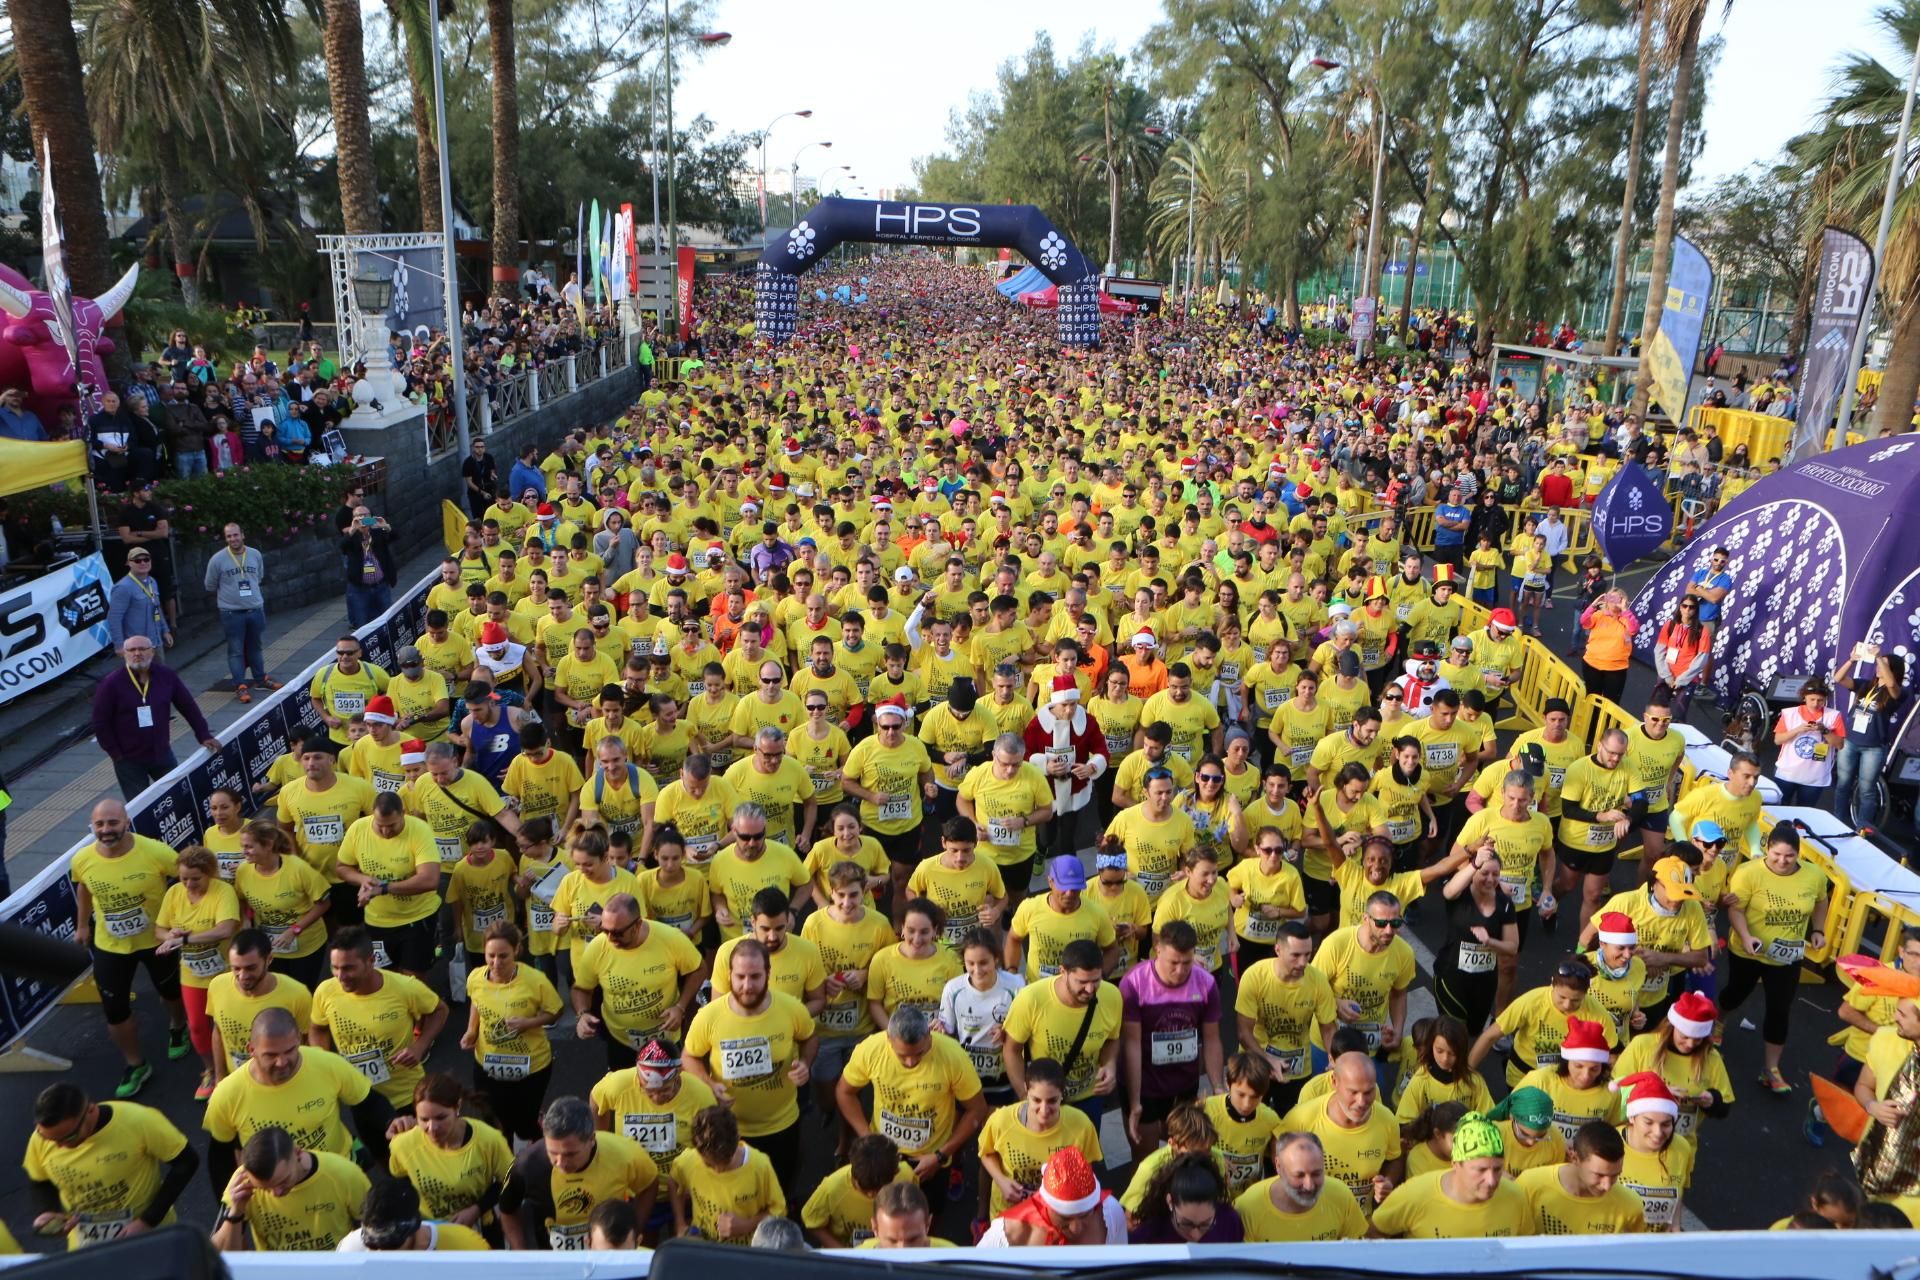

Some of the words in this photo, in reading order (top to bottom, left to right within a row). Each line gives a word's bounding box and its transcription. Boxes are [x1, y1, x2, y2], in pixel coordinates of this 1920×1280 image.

[876, 204, 980, 236] HPS
[757, 311, 776, 319] HPS
[779, 312, 796, 320] HPS
[1074, 323, 1095, 331] HPS
[1797, 464, 1842, 485] PERPETUO
[1839, 476, 1884, 496] SOCORRO
[1611, 515, 1663, 534] HPS
[75, 588, 101, 612] RS
[337, 698, 363, 710] 3993
[1268, 693, 1288, 704] 8533
[254, 719, 269, 736] HPS
[258, 733, 272, 750] SAN
[1108, 738, 1129, 750] 6754
[250, 735, 285, 771] SILVESTRE
[1429, 750, 1454, 762] 4738
[207, 754, 224, 774] HPS
[212, 770, 228, 789] SAN
[376, 778, 401, 793] 3875
[153, 796, 173, 818] HPS
[883, 801, 907, 814] 7635
[159, 811, 177, 834] SAN
[308, 823, 338, 838] 4675
[1591, 831, 1615, 842] 2573
[1150, 854, 1167, 865] SAN
[123, 872, 146, 882] HPS
[965, 881, 984, 889] HPS
[1144, 880, 1163, 892] 709
[951, 900, 969, 910] SAN
[19, 900, 48, 926] HPS
[111, 917, 144, 935] 4192
[1250, 921, 1277, 933] 4658
[1464, 953, 1492, 966] 7026
[643, 964, 666, 975] HPS
[776, 974, 798, 984] HPS
[613, 989, 664, 1010] SILVESTRE
[628, 988, 648, 999] SAN
[1360, 989, 1378, 999] SAN
[373, 1011, 399, 1023] HPS
[819, 1010, 853, 1024] 6726
[355, 1033, 376, 1044] SAN
[1167, 1042, 1183, 1056] 99
[727, 1050, 763, 1068] 5262
[915, 1081, 942, 1091] HPS
[297, 1098, 325, 1113] HPS
[630, 1125, 667, 1142] 3211
[884, 1124, 921, 1142] 8903
[1357, 1149, 1381, 1158] HPS
[1335, 1171, 1359, 1181] SAN
[305, 1203, 335, 1215] HPS
[1587, 1221, 1616, 1232] HPS
[285, 1229, 312, 1244] SAN
[1311, 1229, 1337, 1241] HPS
